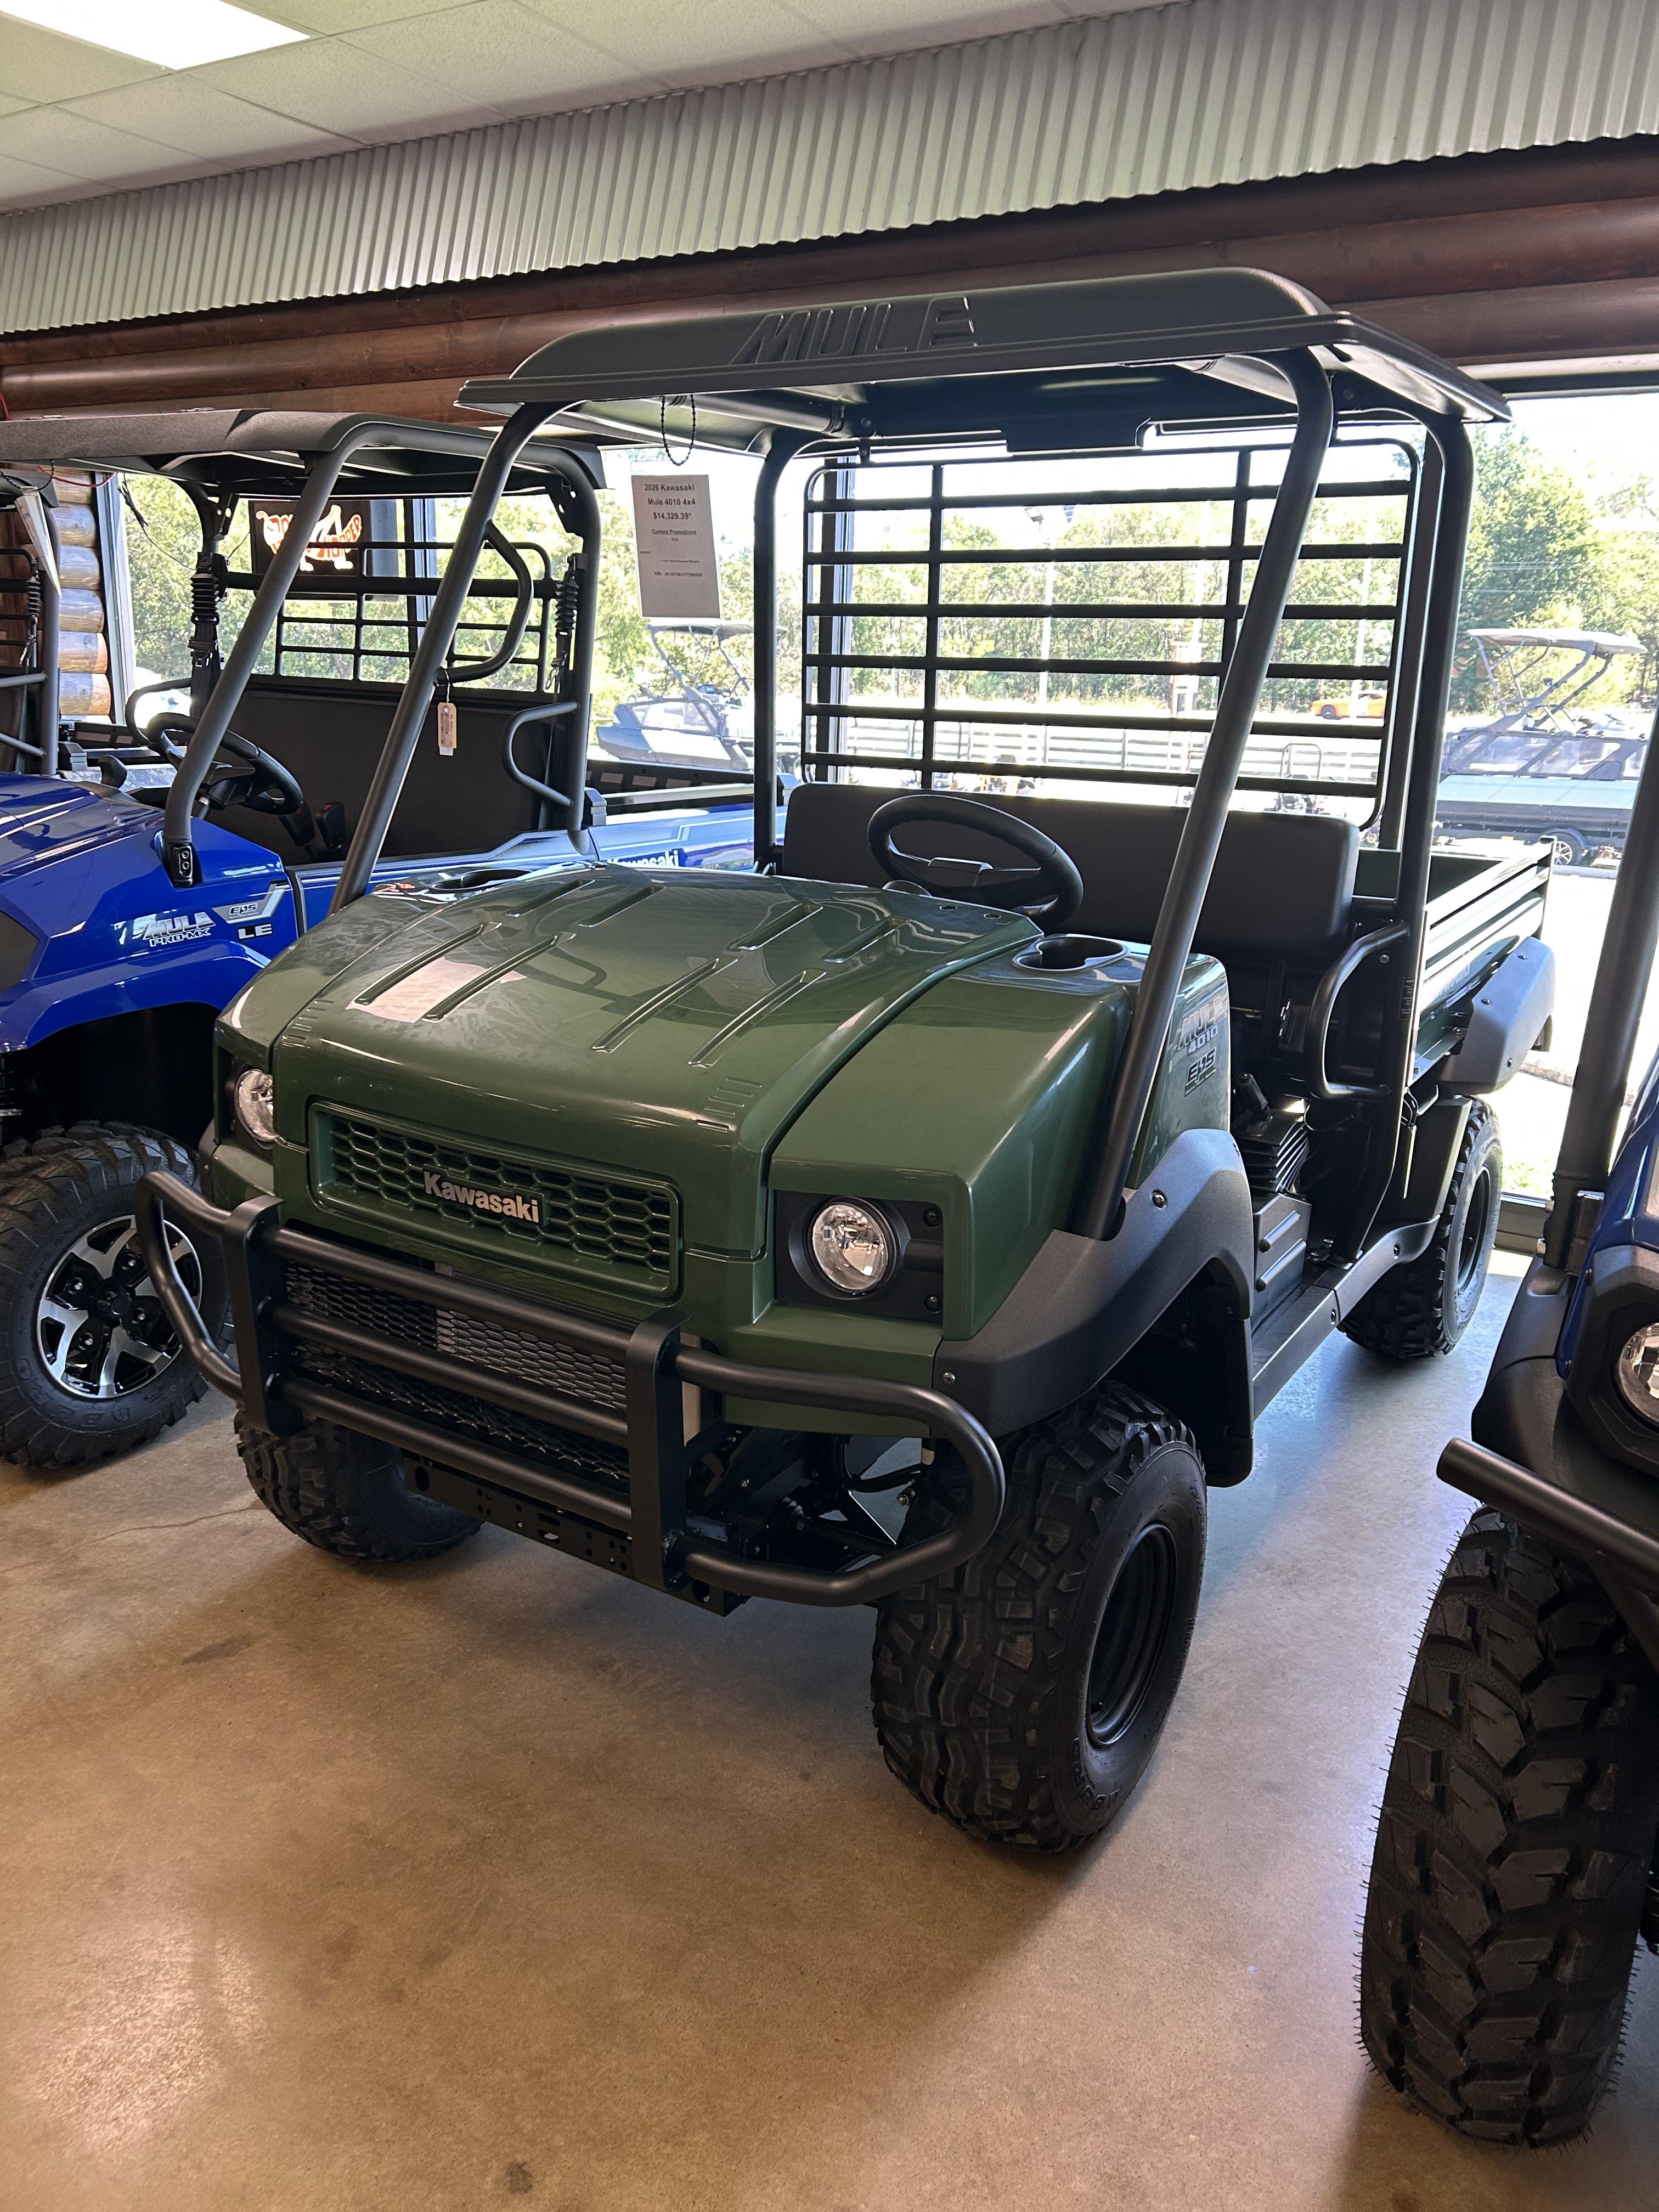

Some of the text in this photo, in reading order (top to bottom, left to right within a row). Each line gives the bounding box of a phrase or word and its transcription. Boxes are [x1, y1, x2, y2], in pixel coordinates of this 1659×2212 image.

[729, 295, 979, 366] MULE
[647, 498, 696, 506] Mule 4010 4x4
[661, 483, 695, 492] Kawasaki
[143, 911, 216, 940] MULE
[149, 927, 211, 947] PRO-MX
[238, 924, 273, 939] LE
[1177, 995, 1229, 1052] MULE
[1188, 1024, 1219, 1055] 4010
[423, 1170, 540, 1223] Kawasaki
